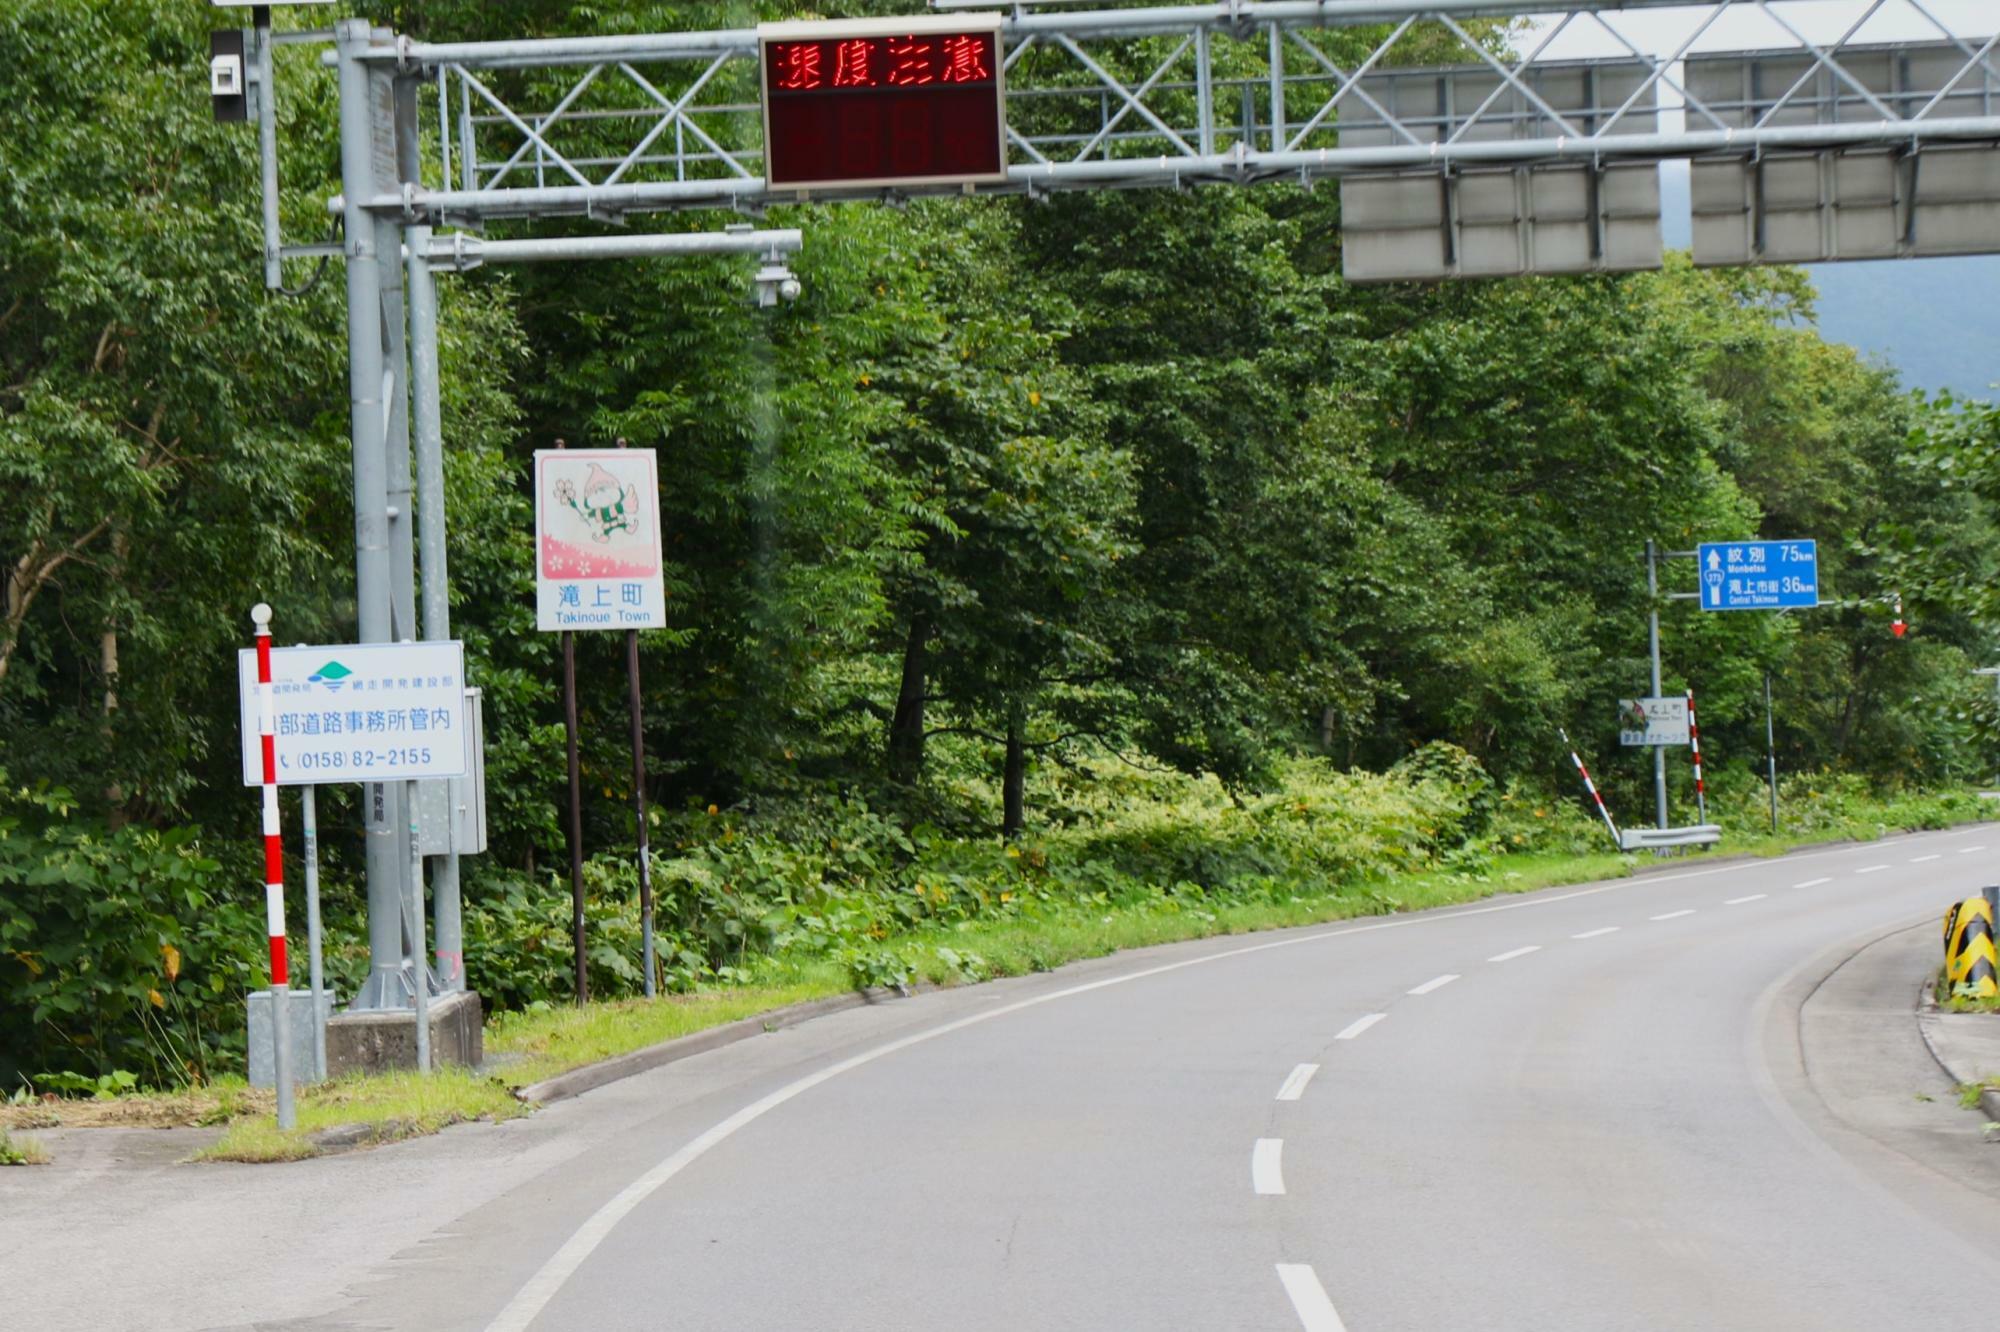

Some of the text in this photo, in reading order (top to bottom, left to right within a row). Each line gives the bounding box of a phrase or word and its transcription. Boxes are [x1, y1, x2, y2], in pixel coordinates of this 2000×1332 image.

[777, 35, 988, 89] 速度注意
[1727, 545, 1813, 563] 紋別 75km
[1728, 564, 1766, 573] Monbetsu
[1782, 576, 1815, 593] 36km
[559, 583, 642, 607] 滝上町
[1729, 596, 1751, 605] Central
[555, 610, 650, 624] Takinoue Town
[258, 707, 451, 736] 部道路事務所管内
[297, 747, 432, 769] (0158)82-2155
